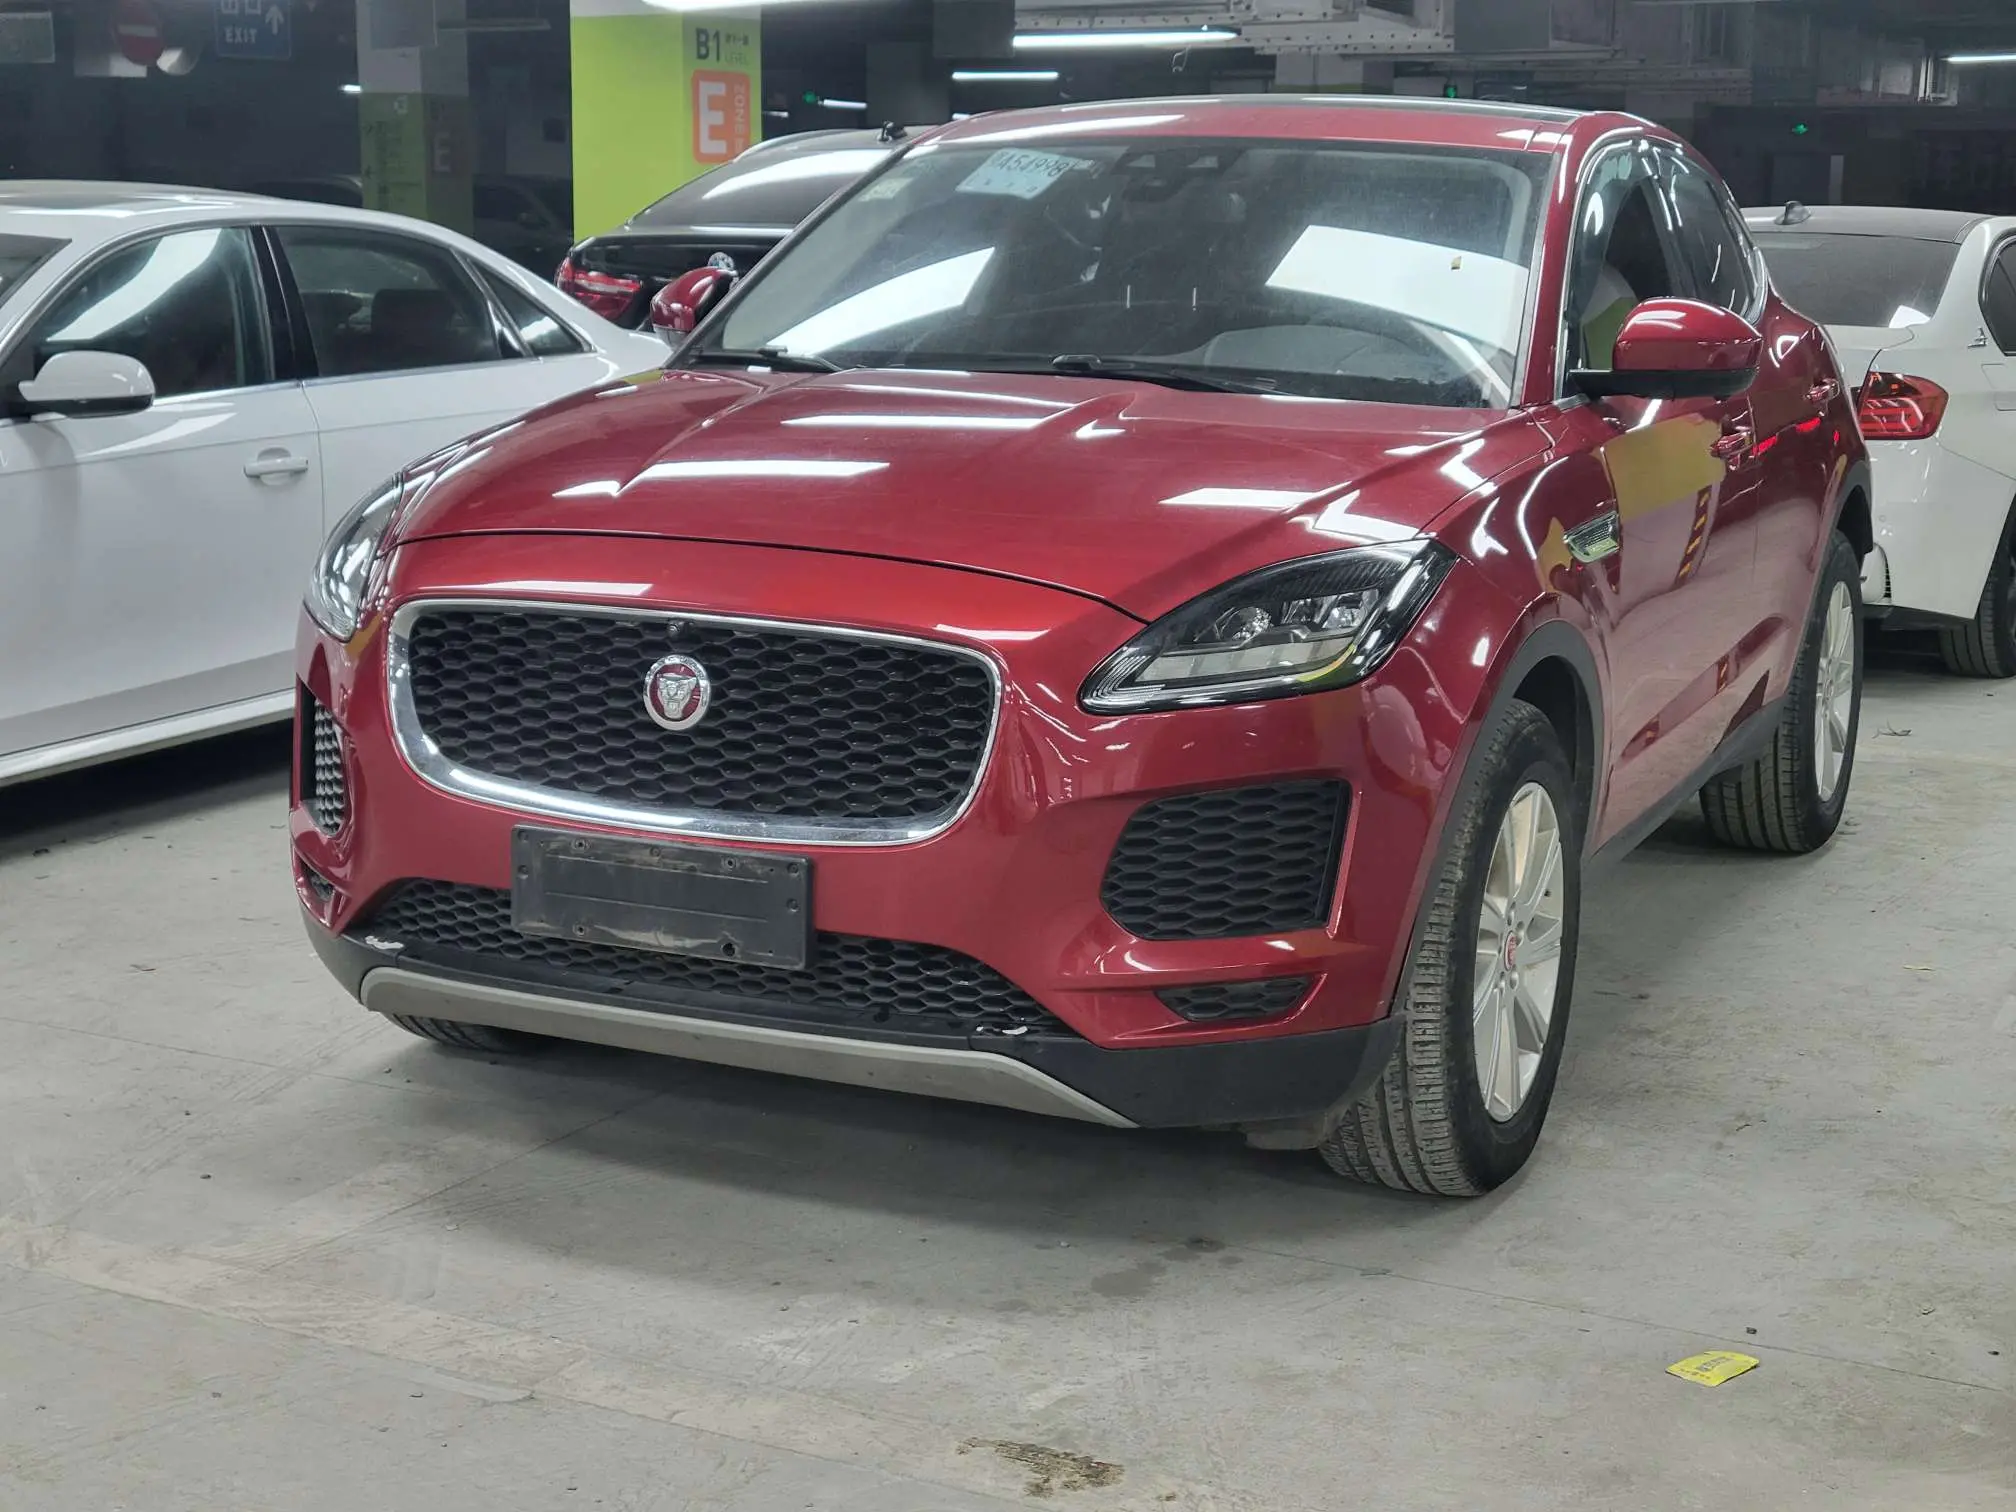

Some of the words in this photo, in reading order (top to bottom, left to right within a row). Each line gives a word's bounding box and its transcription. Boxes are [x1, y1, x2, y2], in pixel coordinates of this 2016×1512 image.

[224, 27, 257, 44] EXIT
[695, 27, 720, 62] B1
[698, 80, 728, 154] E
[433, 131, 451, 173] E
